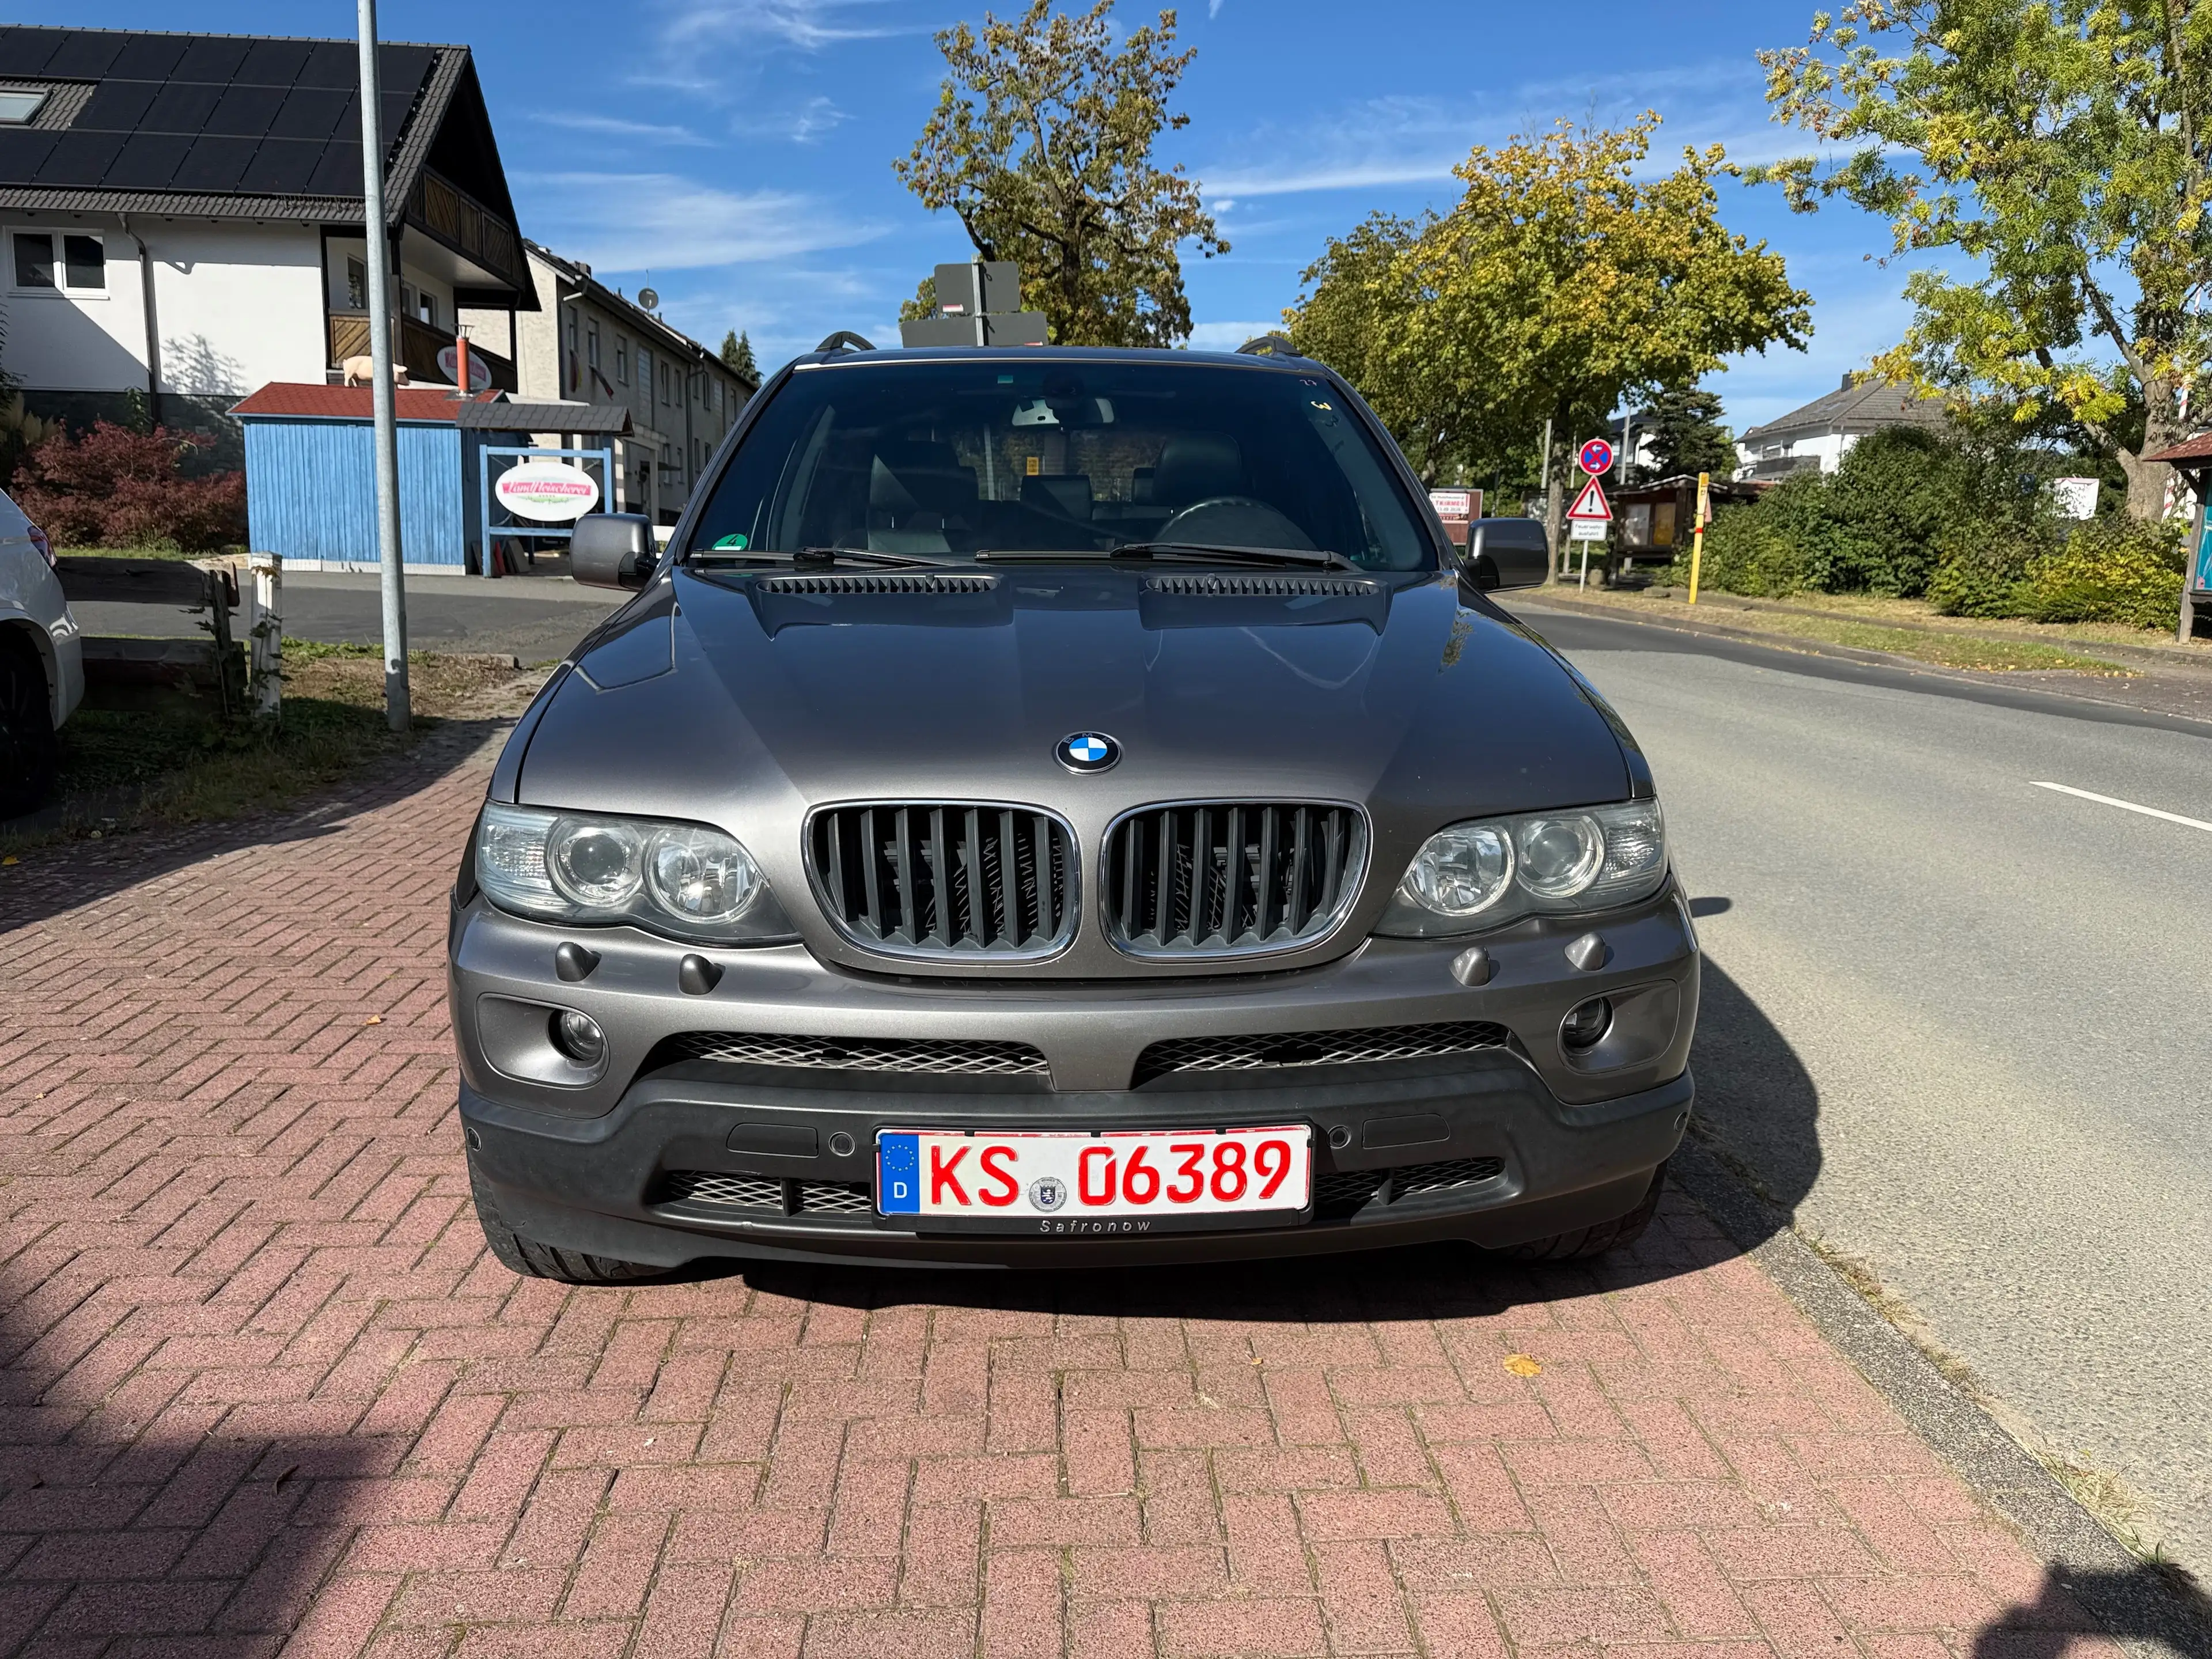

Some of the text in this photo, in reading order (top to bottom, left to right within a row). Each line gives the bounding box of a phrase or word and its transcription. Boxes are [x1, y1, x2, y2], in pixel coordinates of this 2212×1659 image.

[726, 535, 739, 546] 4
[1063, 732, 1113, 744] BMW
[930, 1140, 1291, 1207] KS 06389
[893, 1181, 908, 1199] D
[1040, 1219, 1152, 1233] Safronow
